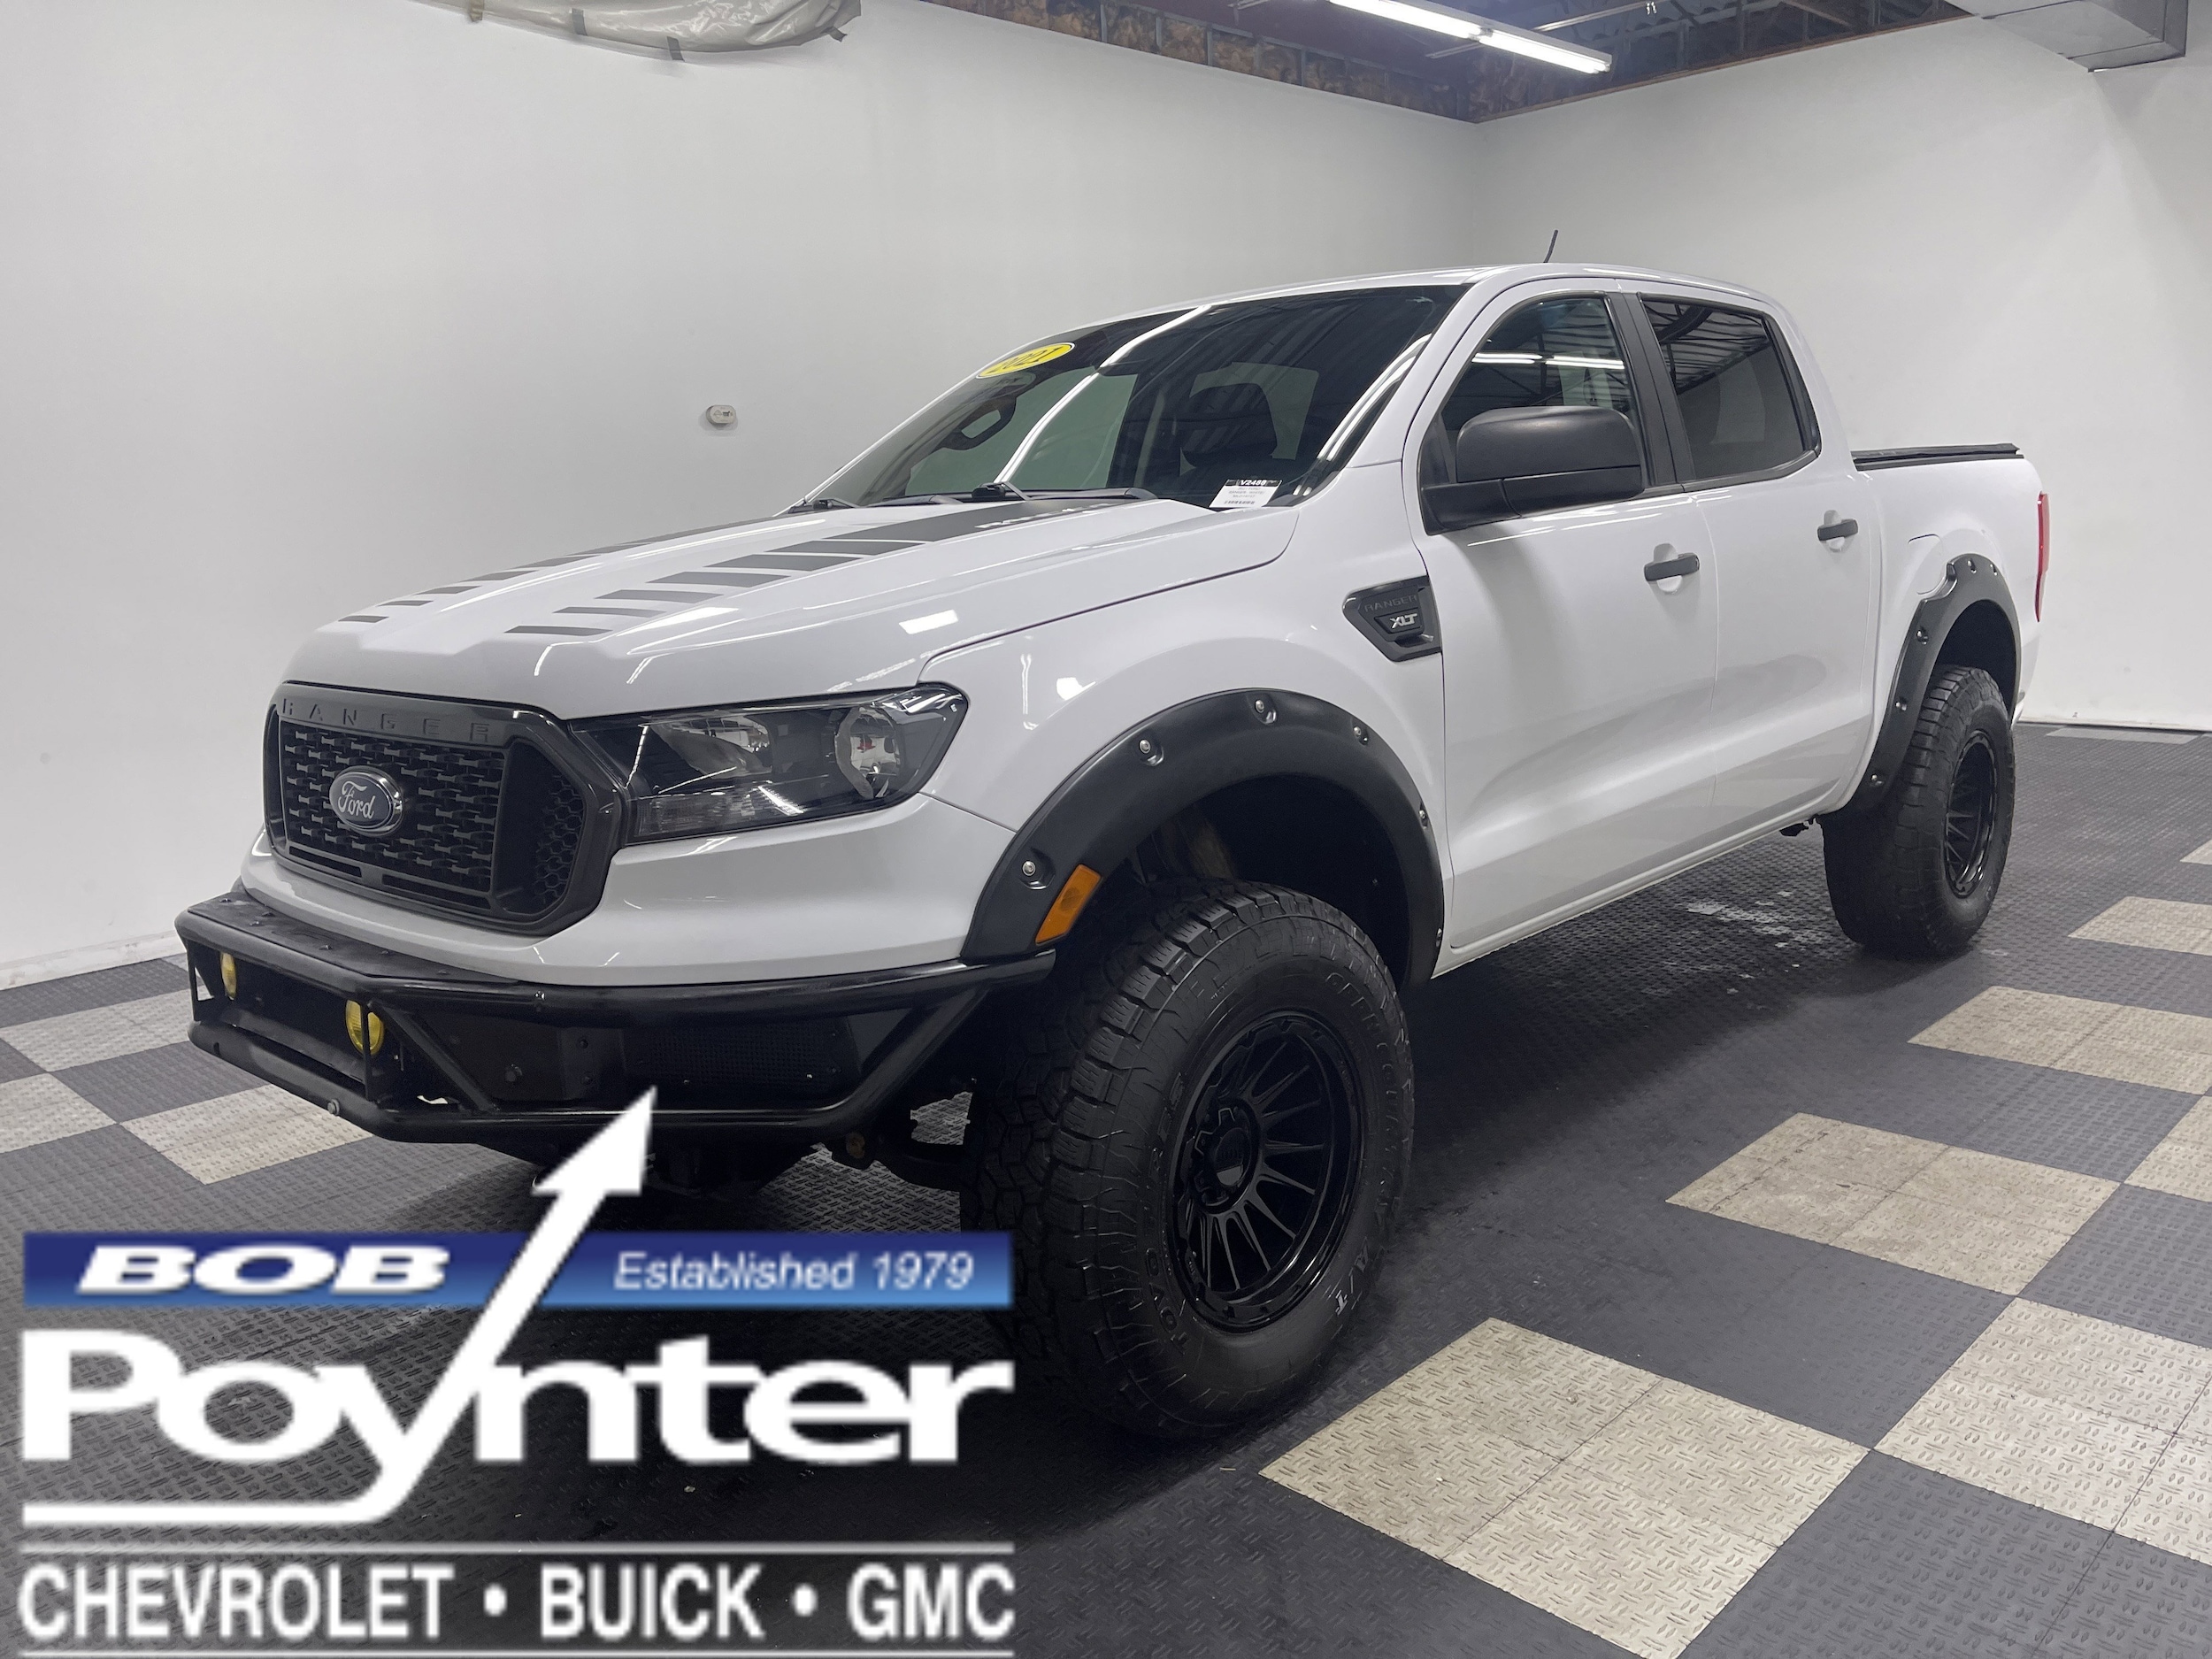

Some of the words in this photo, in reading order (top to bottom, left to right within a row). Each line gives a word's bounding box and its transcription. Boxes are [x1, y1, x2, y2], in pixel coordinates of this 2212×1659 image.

[1390, 613, 1417, 629] XLT
[283, 698, 490, 743] RANGER
[337, 780, 376, 819] Ford
